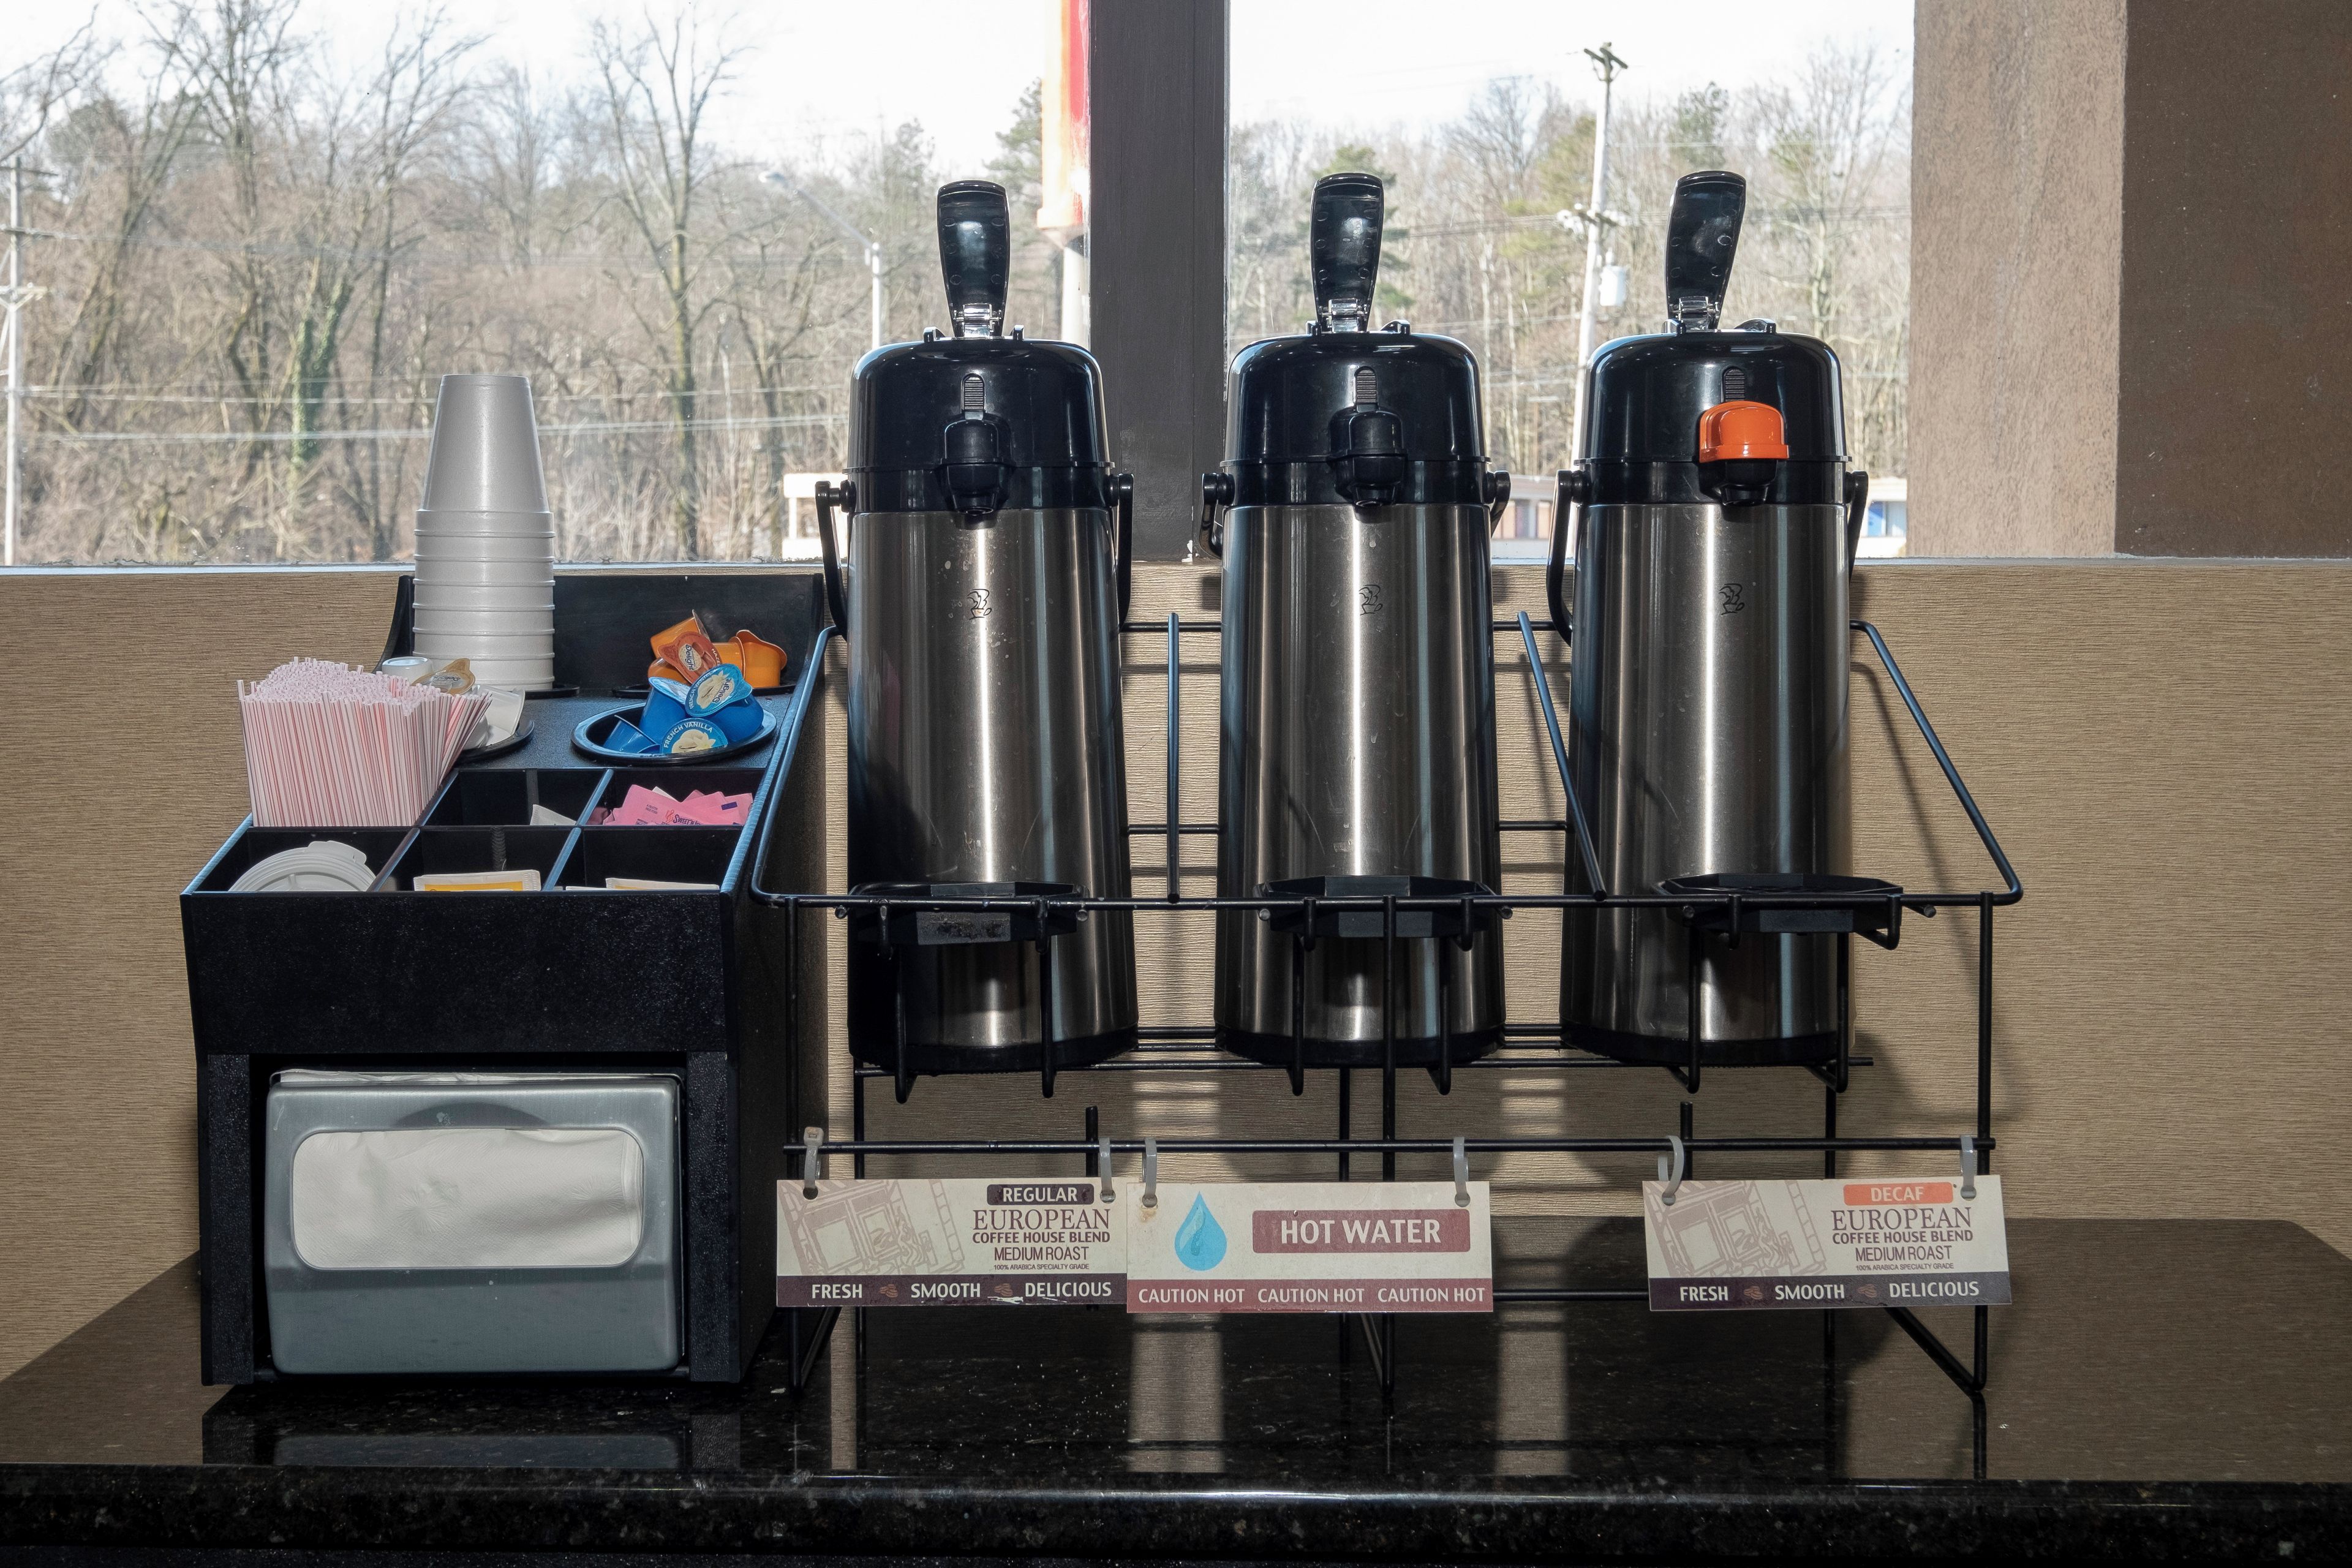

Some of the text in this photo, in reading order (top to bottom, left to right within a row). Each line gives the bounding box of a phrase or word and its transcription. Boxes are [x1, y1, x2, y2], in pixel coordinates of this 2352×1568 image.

[685, 644, 695, 671] Delight
[712, 677, 732, 703] Delight
[663, 721, 713, 748] FRENCH VANILLA
[1003, 1187, 1078, 1202] REGULAR
[1871, 1186, 1924, 1202] DECAF
[973, 1208, 1111, 1231] EUROPEAN
[1831, 1207, 1972, 1231] EUROPEAN
[972, 1231, 1111, 1244] COFFEE HOUSE BLEND
[1281, 1219, 1441, 1245] HOT WATER
[1832, 1230, 1973, 1245] COFFEE HOUSE BLEND
[994, 1246, 1090, 1261] MEDIUM ROAST
[1855, 1245, 1952, 1262] MEDIUM ROAST
[812, 1281, 1112, 1300] FRESH SMOOTH DELICIOUS
[1138, 1287, 1486, 1303] CAUTION HOT CAUTION HOT CAUTION HOT
[1679, 1281, 1980, 1302] FRESH SMOOTH DELICIOUS
